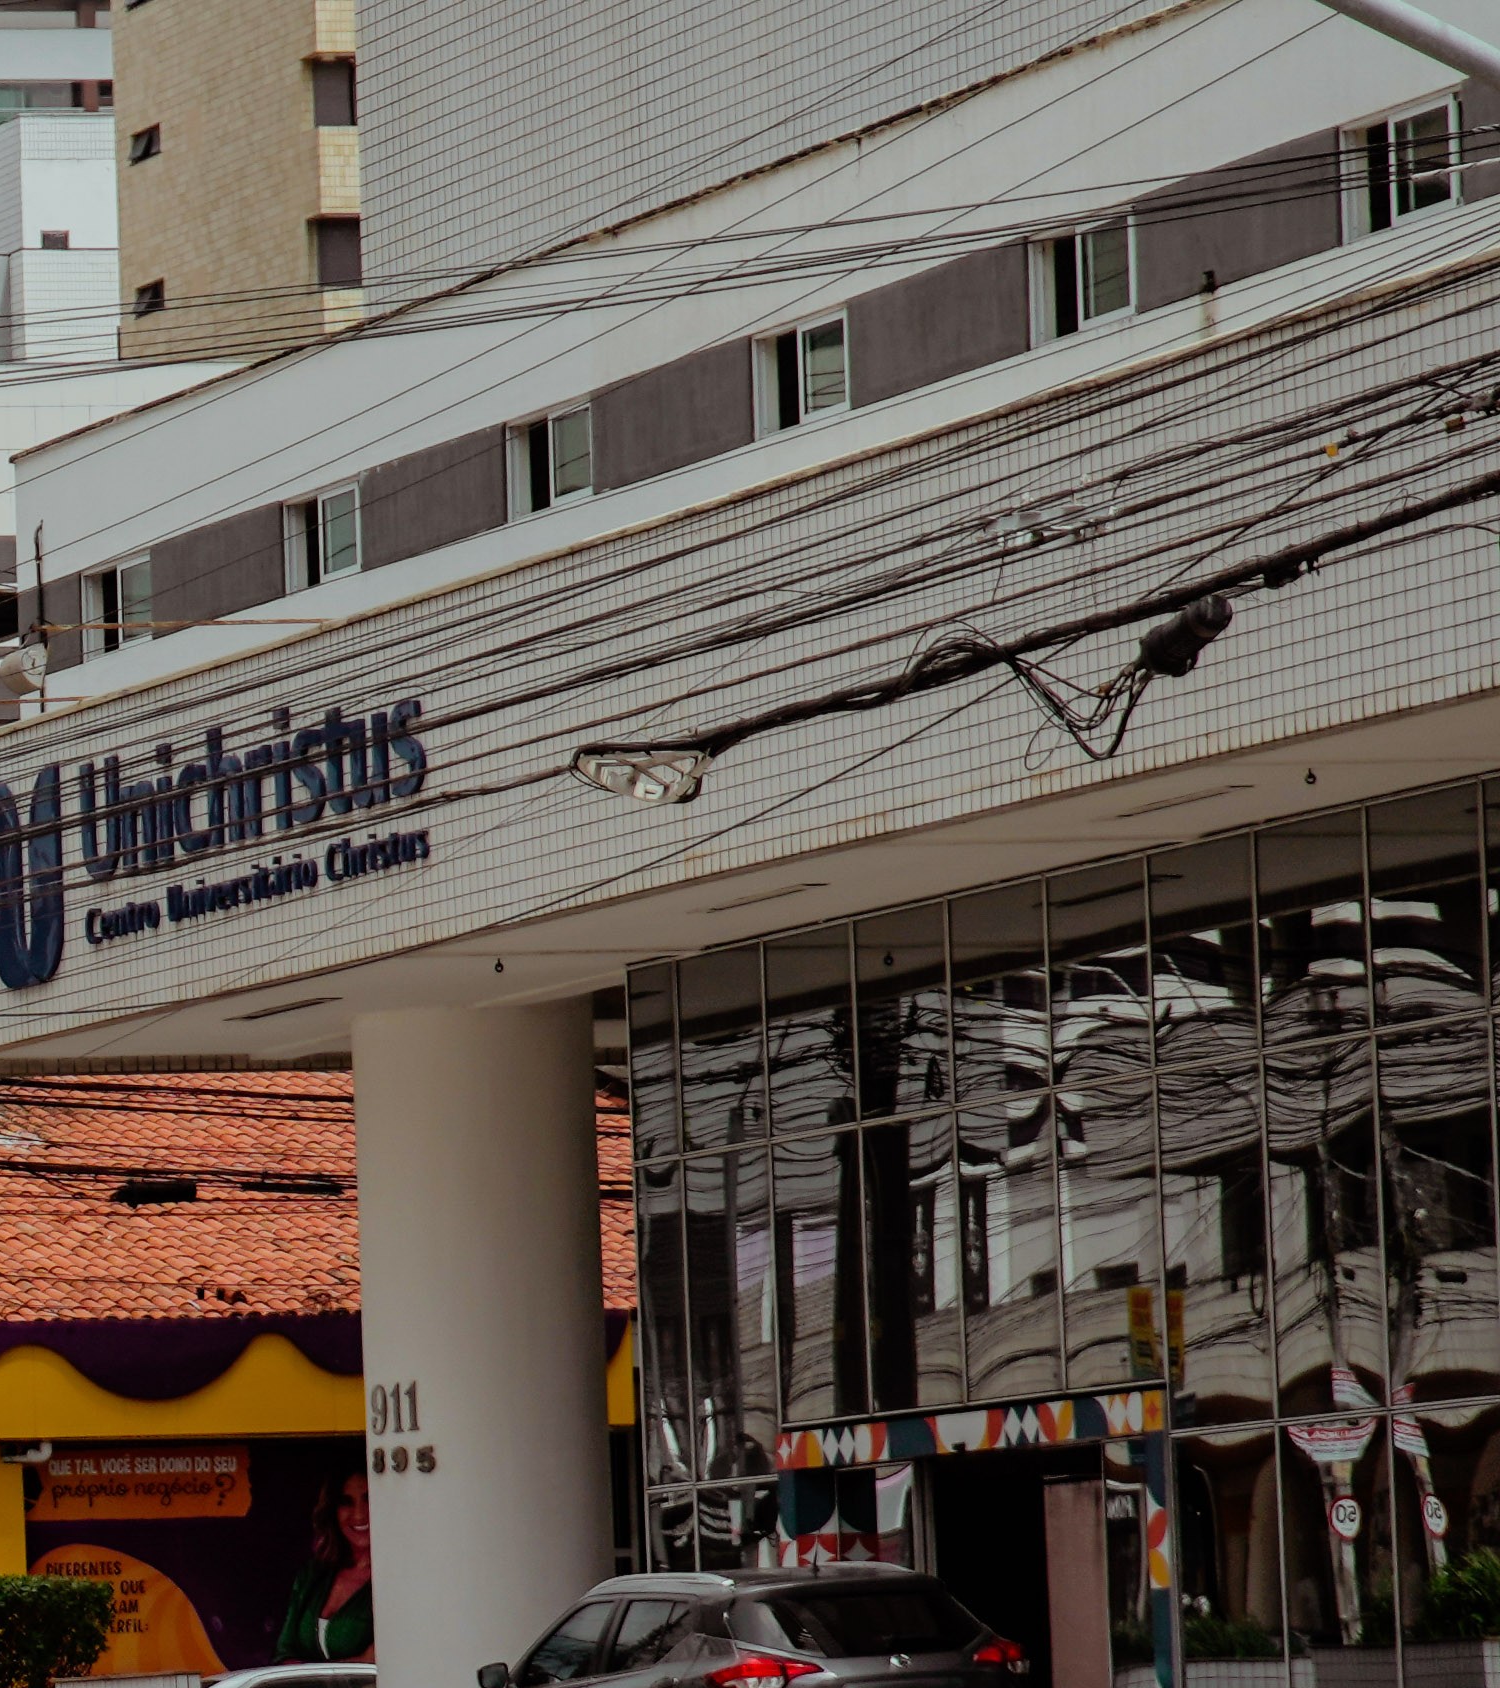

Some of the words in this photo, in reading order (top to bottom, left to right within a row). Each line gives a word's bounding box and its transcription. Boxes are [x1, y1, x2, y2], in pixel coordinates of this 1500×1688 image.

[80, 700, 426, 880] Unichristus
[85, 902, 160, 944] Centro
[167, 853, 318, 923] Universitário
[325, 829, 430, 884] Christus
[371, 1380, 420, 1435] 911
[48, 1459, 72, 1475] QUE
[76, 1459, 97, 1475] TAL
[101, 1454, 131, 1474] VOCÊ
[134, 1457, 158, 1474] SER
[160, 1457, 189, 1473] DONO
[194, 1457, 210, 1473] DO
[213, 1456, 237, 1473] SEU
[372, 1446, 437, 1474] 895
[51, 1478, 129, 1508] próprio
[46, 1560, 122, 1577] DIFERENTES
[121, 1580, 146, 1595] QUE
[109, 1618, 149, 1633] ERFIL:
